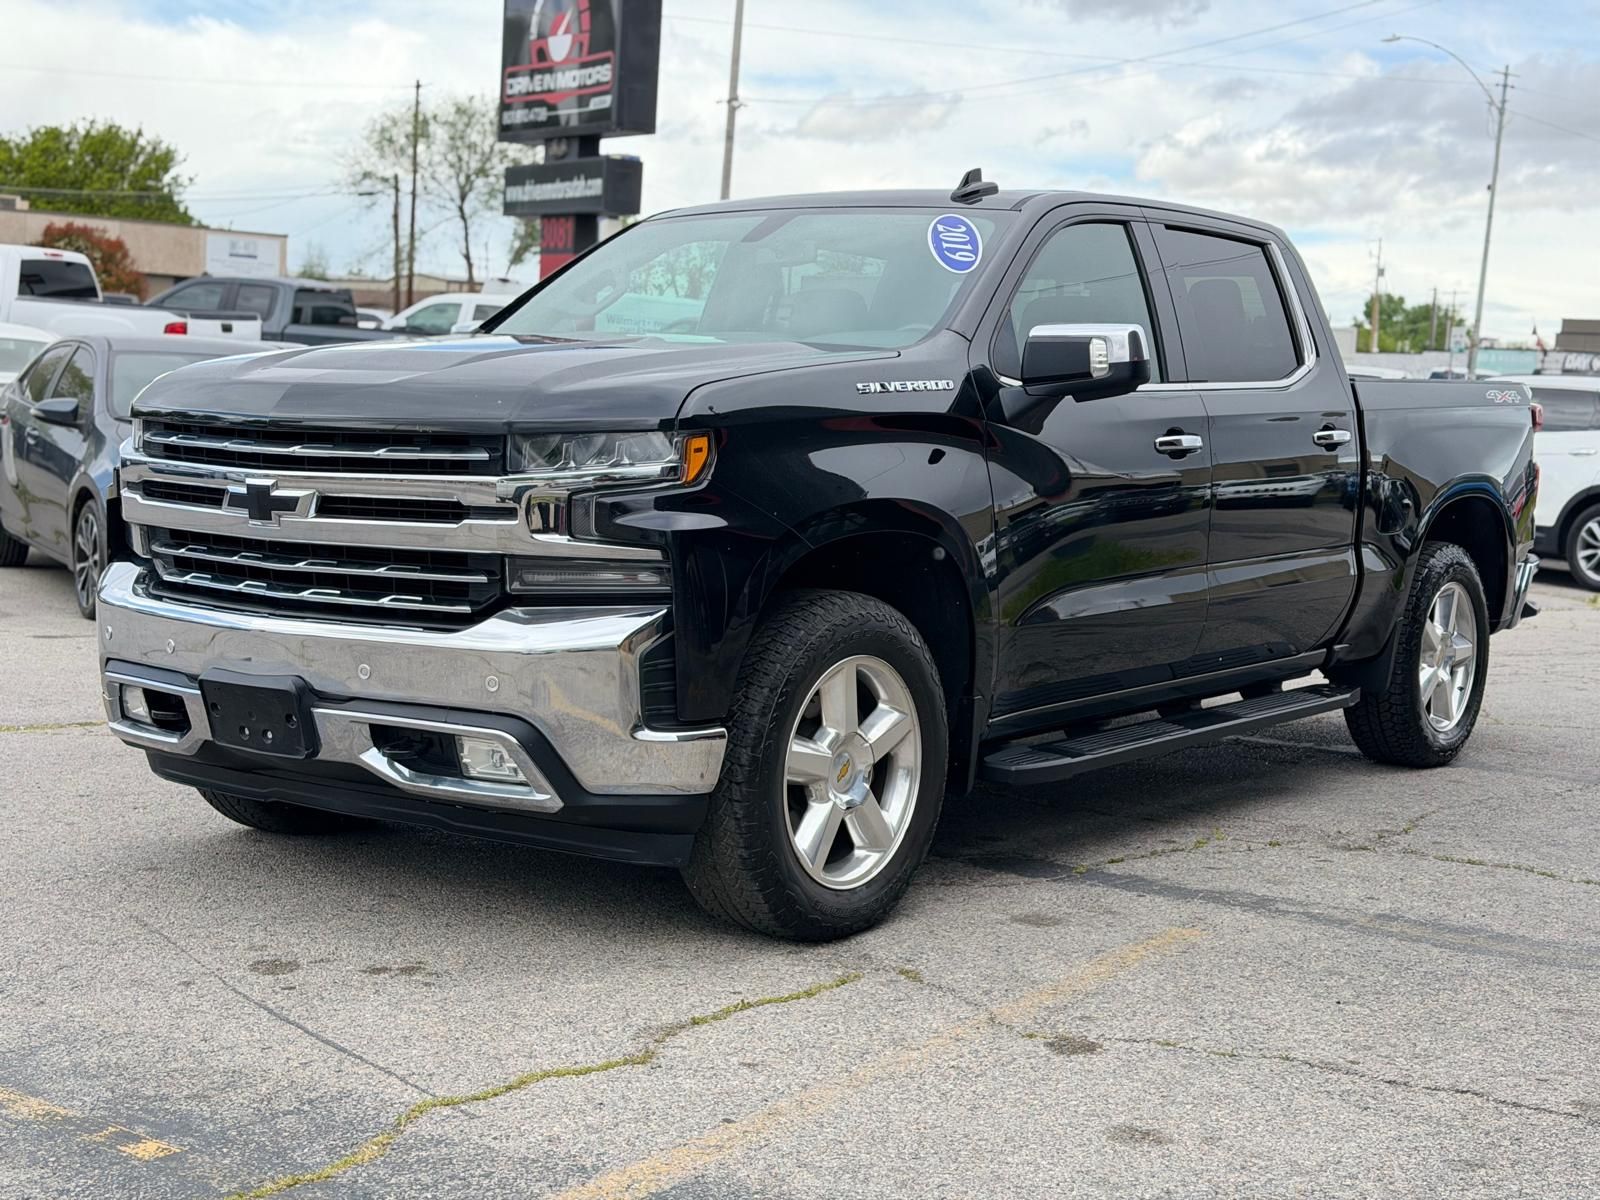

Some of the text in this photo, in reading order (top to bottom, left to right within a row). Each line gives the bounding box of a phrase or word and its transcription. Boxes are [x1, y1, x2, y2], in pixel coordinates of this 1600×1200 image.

[556, 64, 612, 90] MOTORS
[936, 223, 976, 262] 2019
[856, 380, 954, 394] SILVERADO
